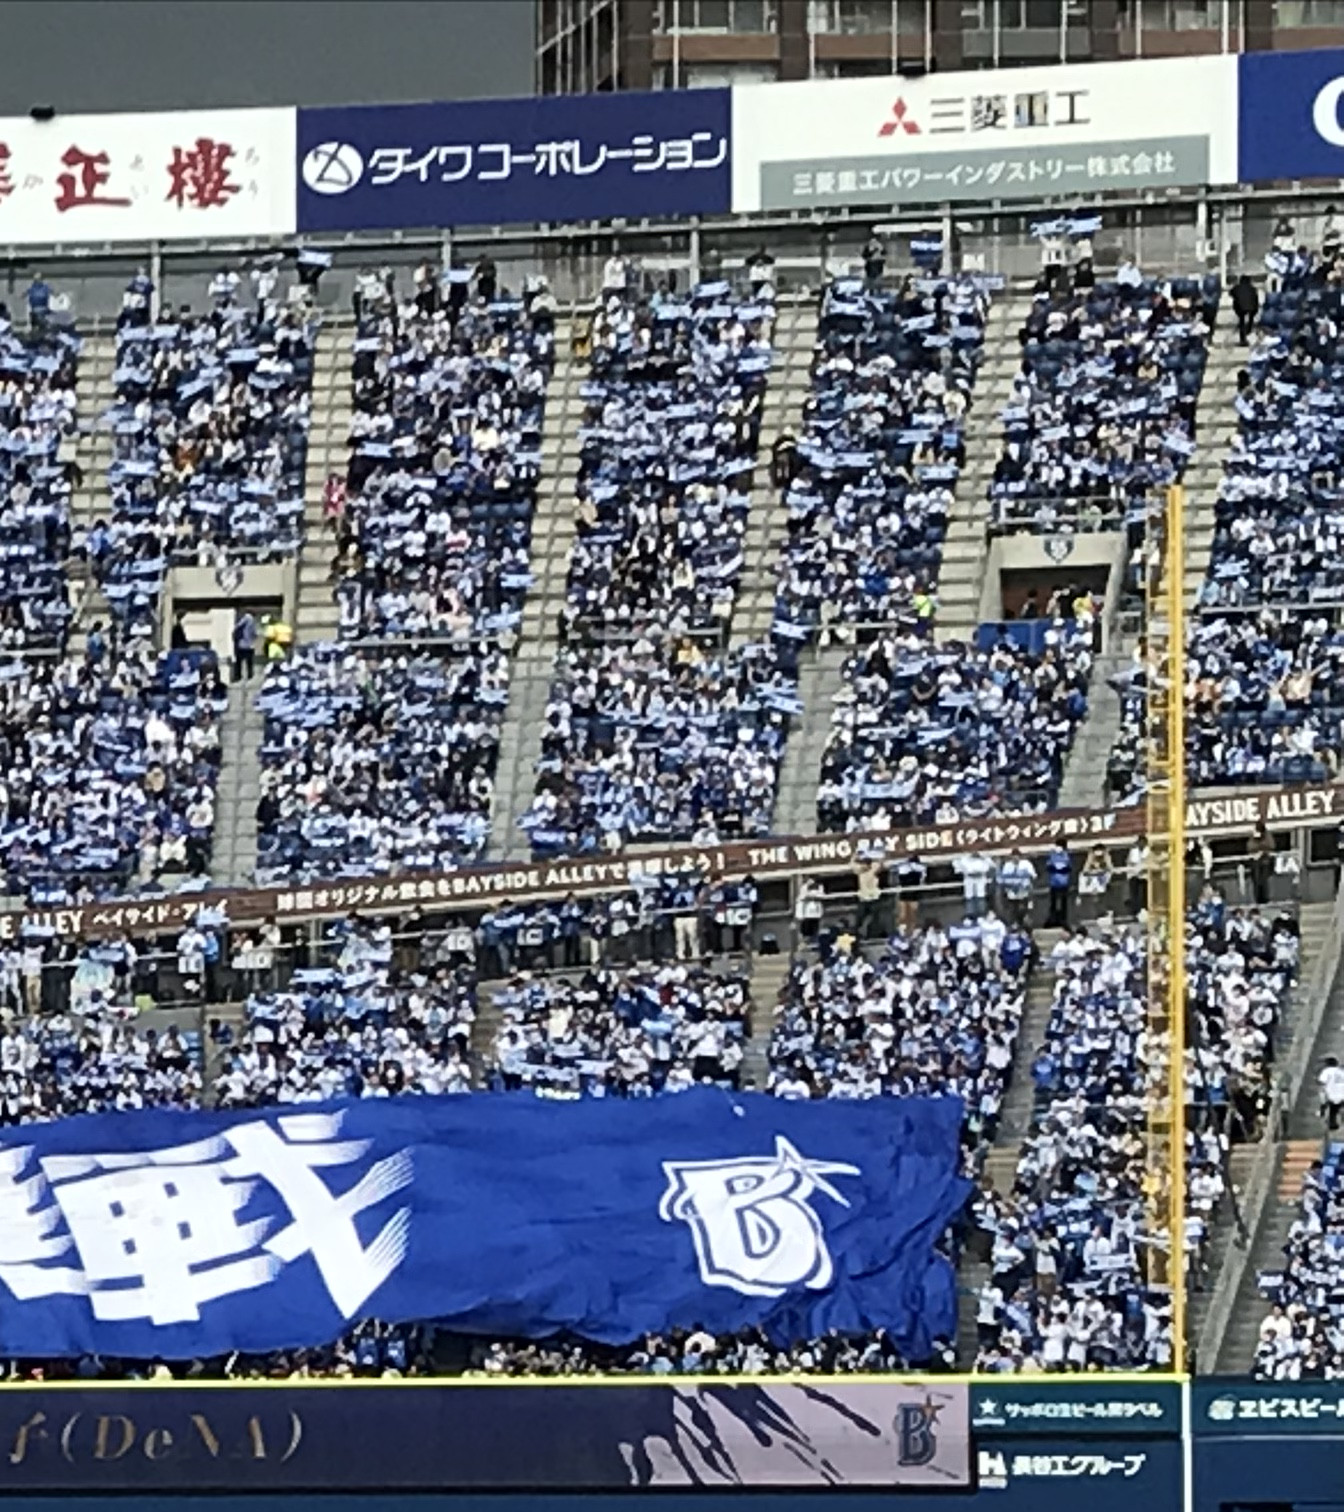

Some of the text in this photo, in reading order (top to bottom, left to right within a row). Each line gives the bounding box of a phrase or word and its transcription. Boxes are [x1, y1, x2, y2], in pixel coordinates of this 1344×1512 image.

[929, 90, 1092, 134] 三菱重工
[792, 150, 1176, 196] 三菱重工パワーインダストリー株式会社
[1184, 789, 1335, 827] AYSIDE ALLEY
[748, 847, 788, 867] THE
[793, 839, 852, 862] WING
[1012, 1453, 1147, 1476] 長谷工グループ
